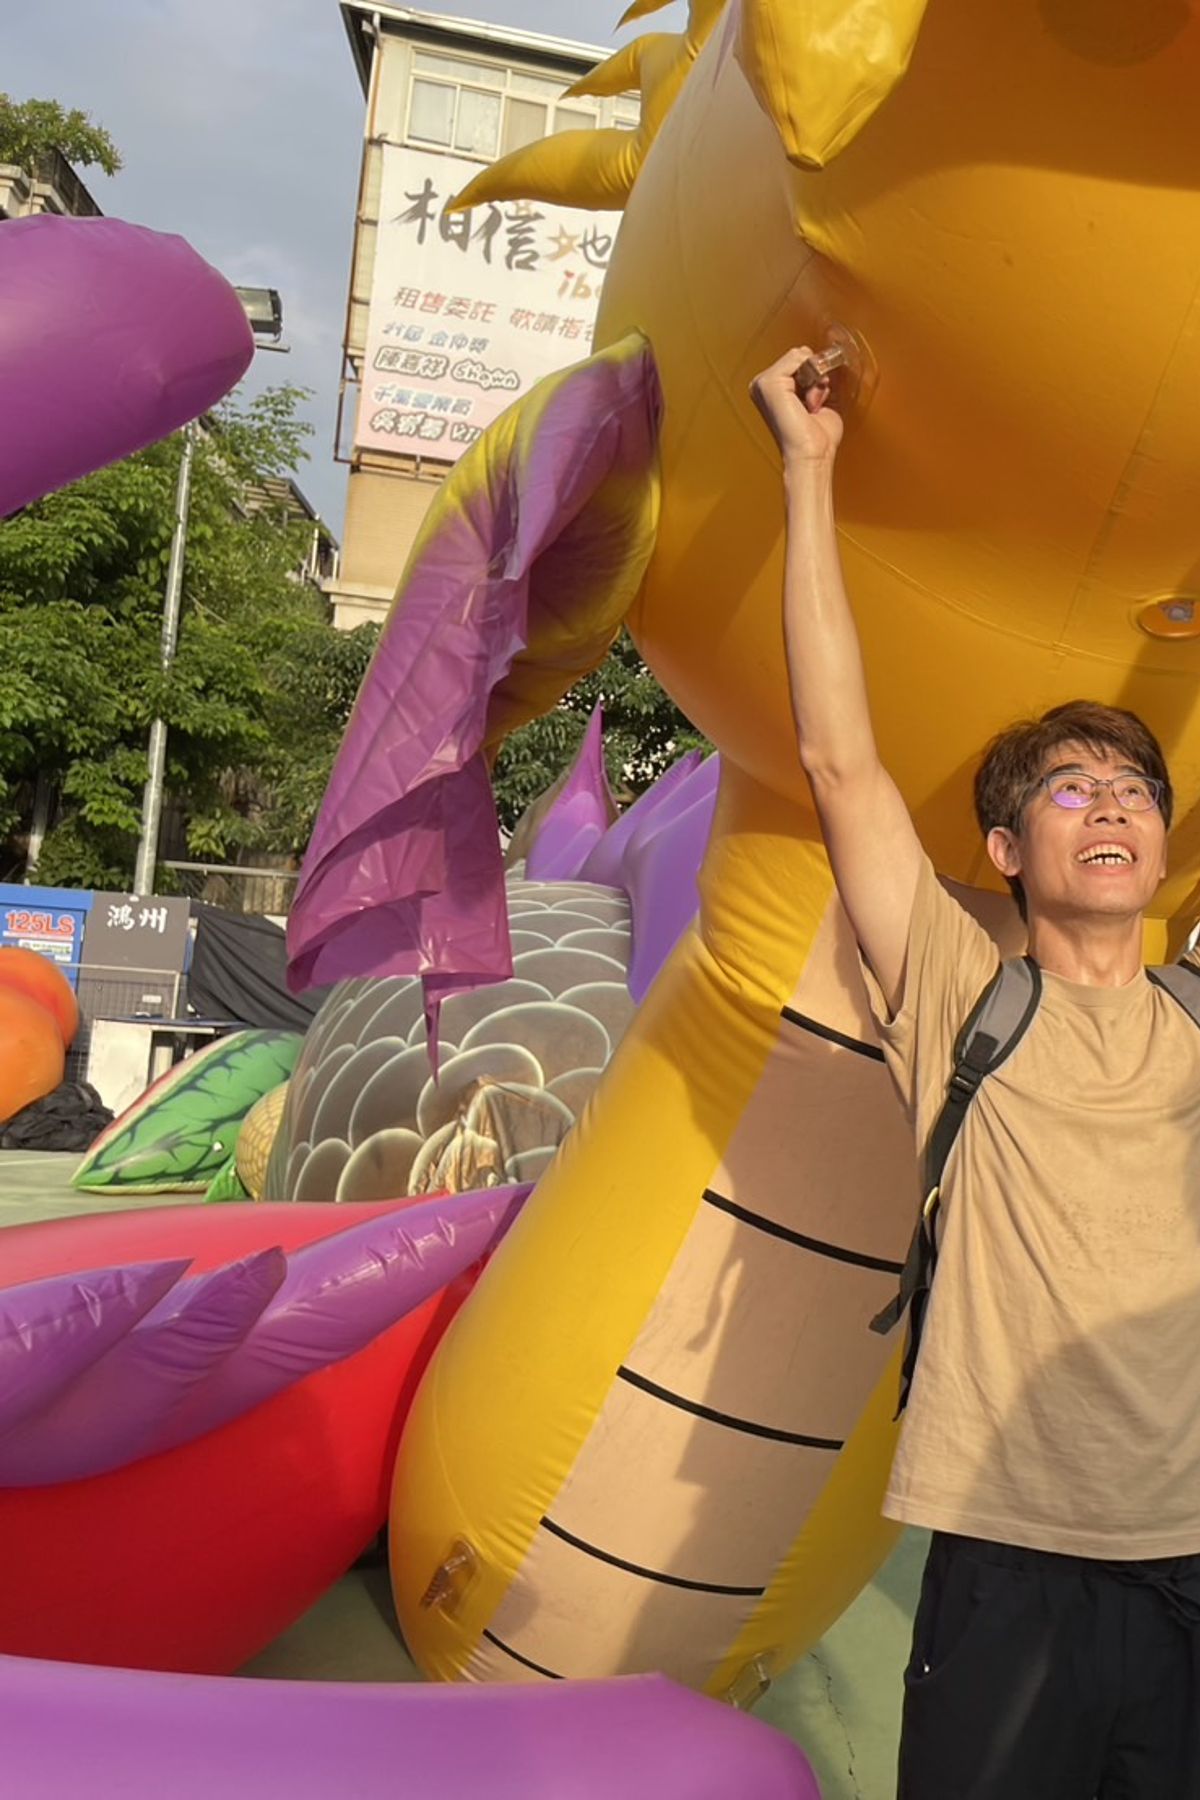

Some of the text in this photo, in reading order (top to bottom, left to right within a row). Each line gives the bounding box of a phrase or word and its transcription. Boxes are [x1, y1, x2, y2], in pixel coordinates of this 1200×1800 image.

[393, 286, 497, 324] 租售委託
[6, 910, 75, 935] 125LS
[107, 904, 168, 933] 鴻州
